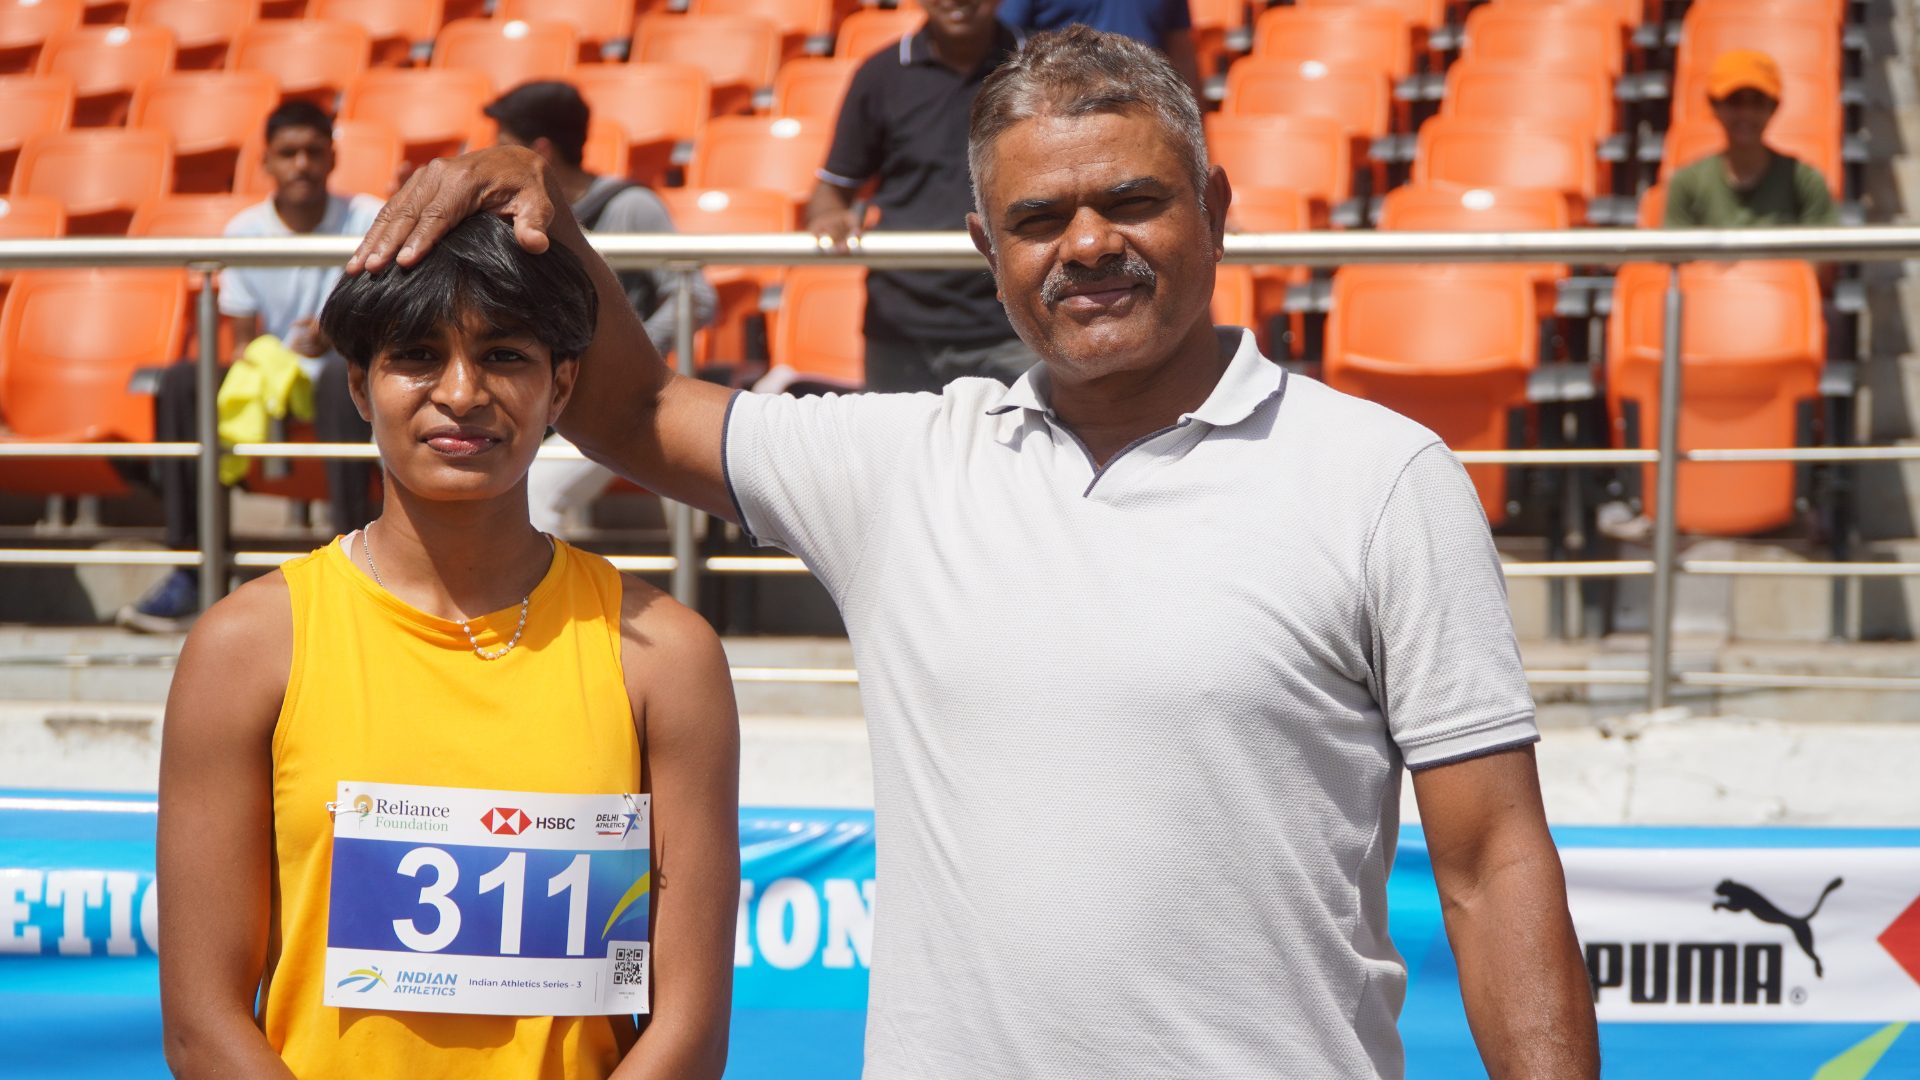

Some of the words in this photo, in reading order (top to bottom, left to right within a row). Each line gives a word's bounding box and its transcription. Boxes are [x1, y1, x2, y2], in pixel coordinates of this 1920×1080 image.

[376, 799, 450, 818] Reliance
[375, 816, 449, 832] Foundation
[536, 817, 576, 830] HSBC
[596, 814, 619, 822] DELHI
[392, 847, 591, 956] 311
[396, 970, 458, 986] INDIAN
[1585, 943, 1782, 1004] PUMA
[393, 985, 457, 997] ATHLETICS
[468, 978, 499, 987] Indian
[500, 979, 541, 989] Athletics
[542, 980, 569, 989] Series
[575, 980, 582, 989] 3
